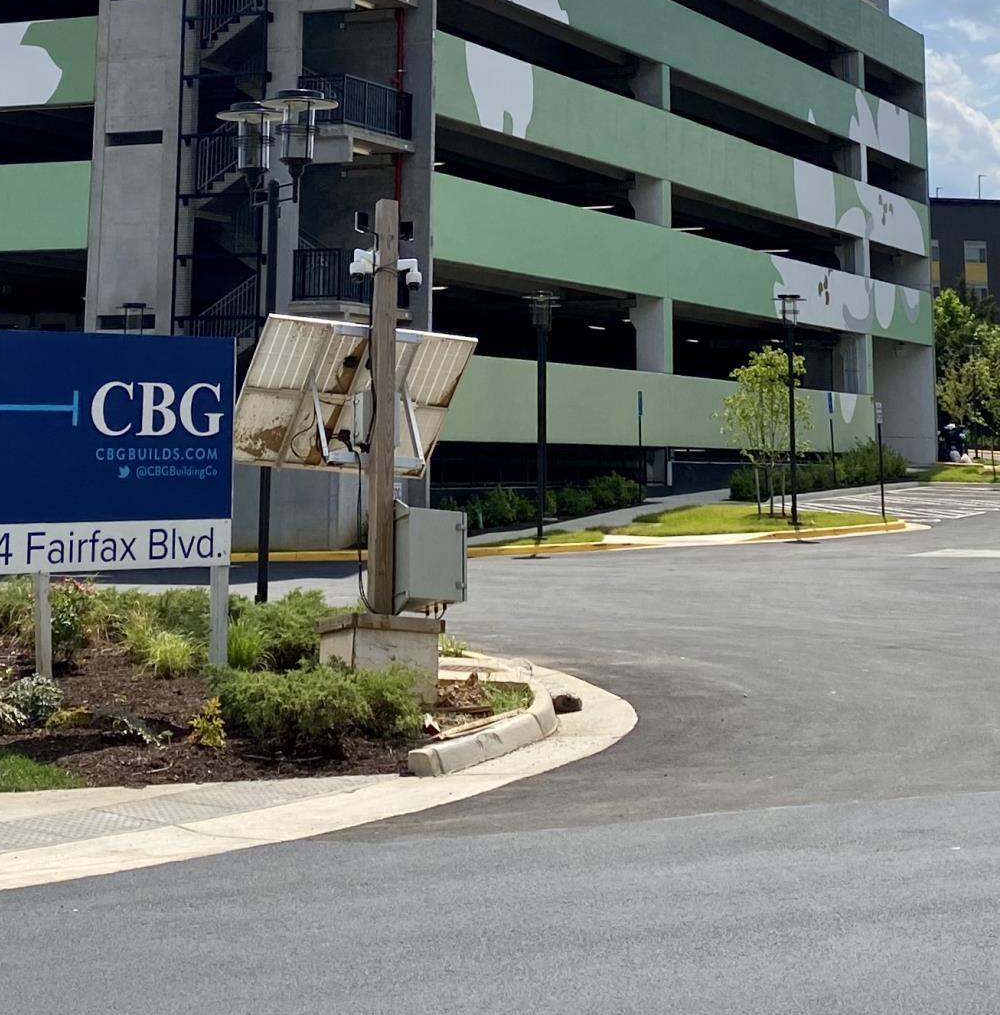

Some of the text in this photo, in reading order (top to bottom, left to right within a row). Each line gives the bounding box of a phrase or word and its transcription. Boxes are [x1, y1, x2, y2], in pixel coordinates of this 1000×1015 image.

[91, 381, 224, 436] CBG
[95, 447, 218, 461] CBGBUILDS.COM
[136, 465, 218, 480] @CBGBuildingCo
[26, 530, 137, 564] Fairfax
[149, 527, 222, 560] Blvd.
